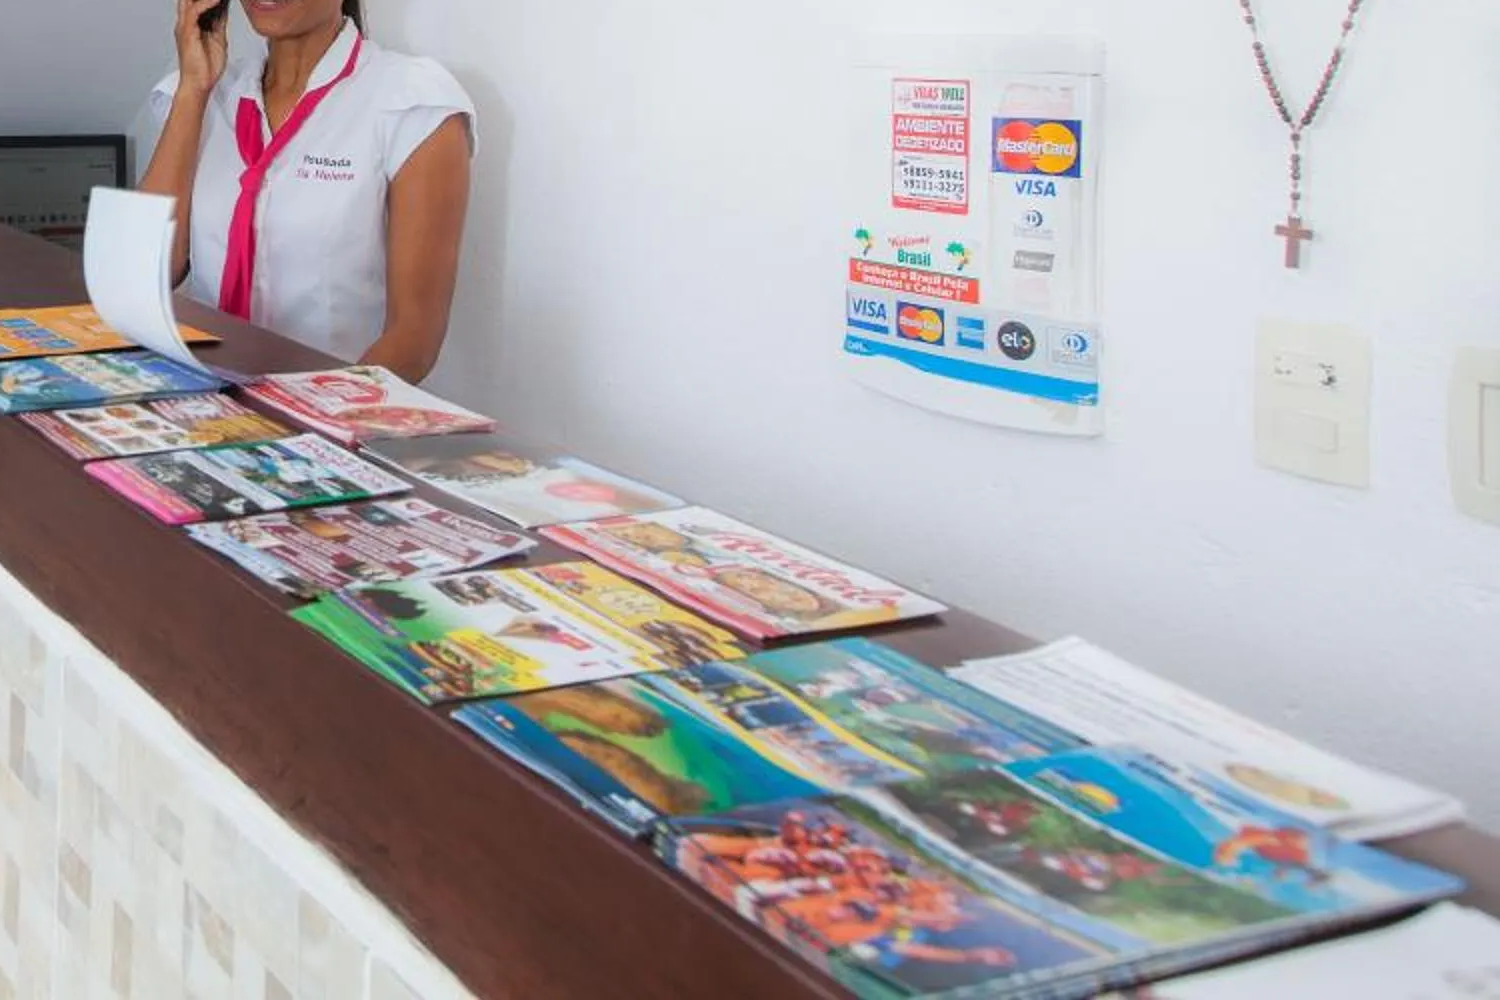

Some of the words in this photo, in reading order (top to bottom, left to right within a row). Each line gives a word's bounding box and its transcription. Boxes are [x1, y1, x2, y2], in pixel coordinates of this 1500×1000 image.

[896, 119, 965, 135] AMBIENTE
[303, 154, 351, 167] Pousada
[1015, 179, 1056, 197] VISA
[897, 249, 931, 266] Brasil
[910, 271, 942, 285] Brasil
[852, 296, 886, 319] VISA
[1001, 332, 1031, 350] elo
